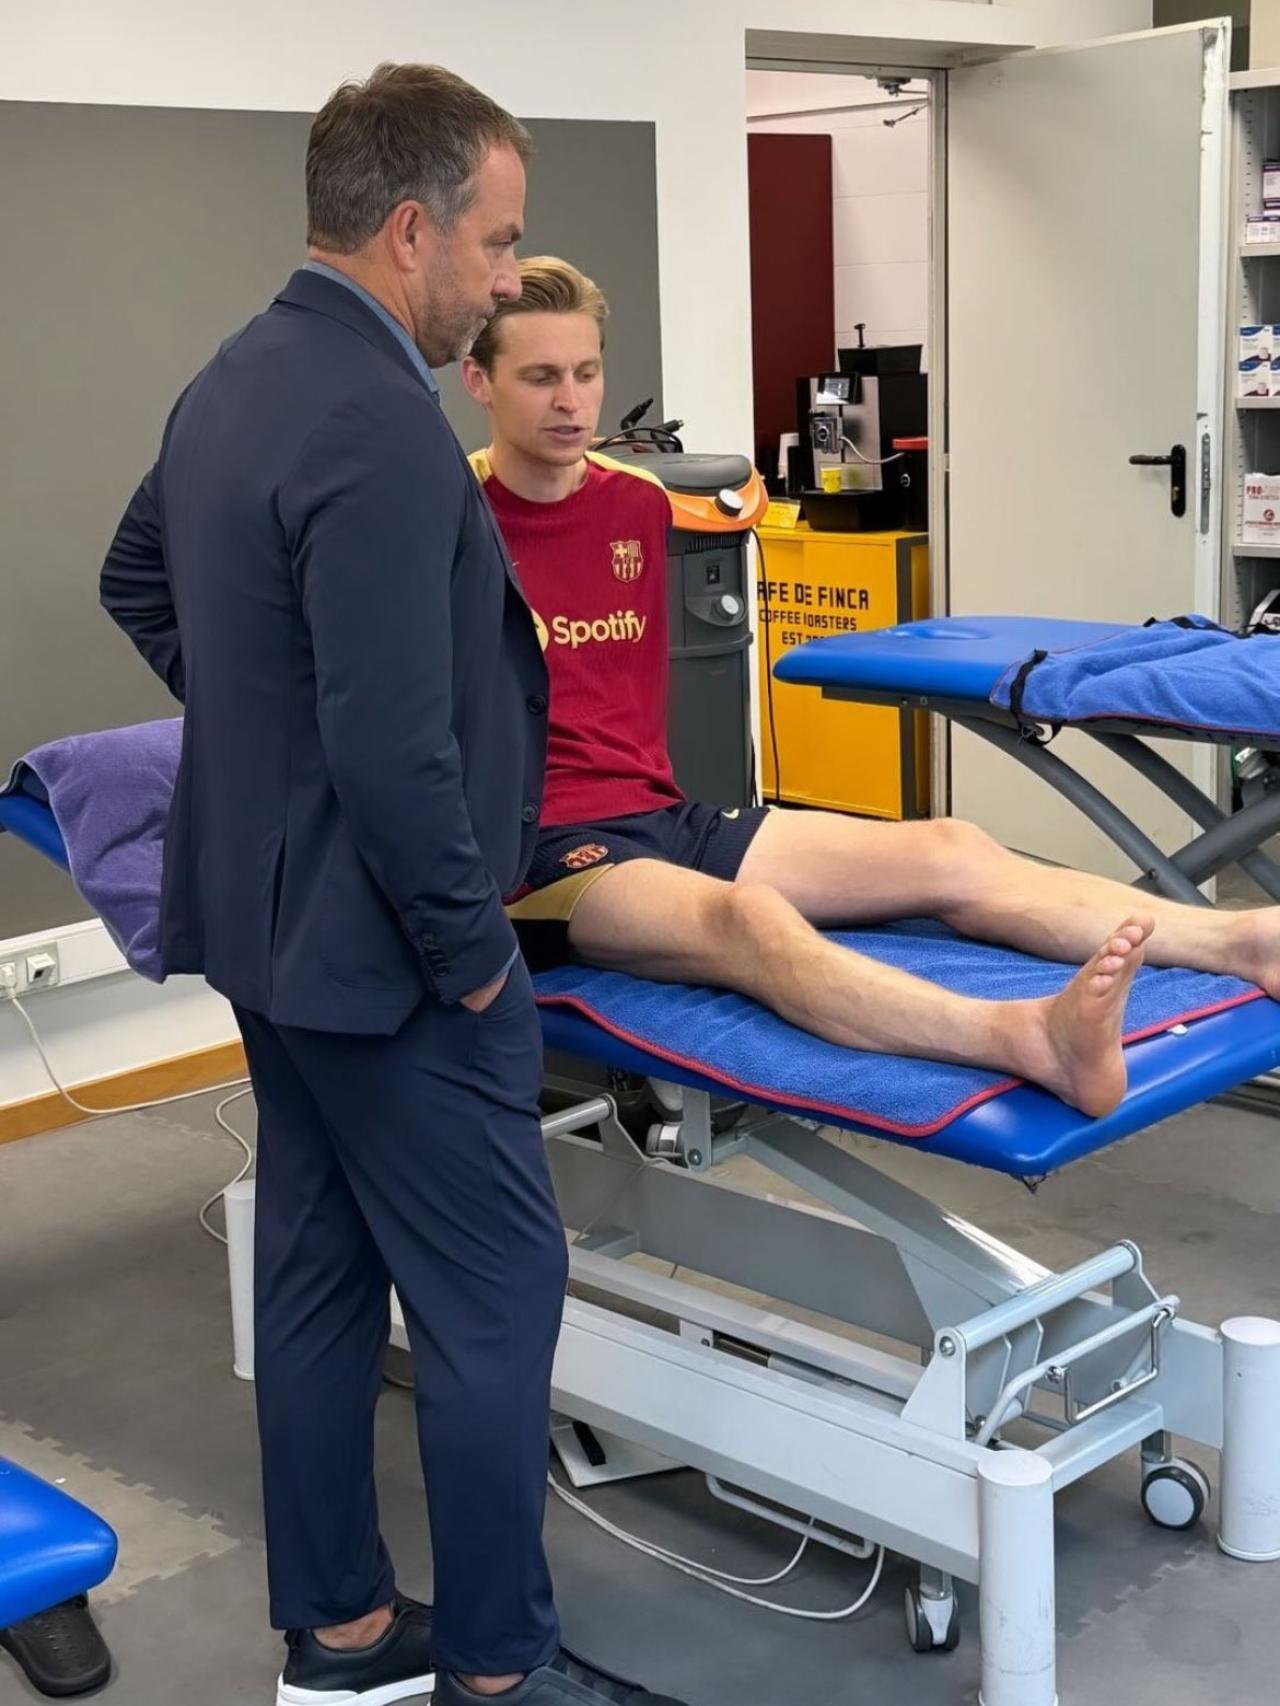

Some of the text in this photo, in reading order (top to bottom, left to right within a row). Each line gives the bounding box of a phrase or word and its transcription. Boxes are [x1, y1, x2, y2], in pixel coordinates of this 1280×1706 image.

[757, 581, 869, 610] AFE DE FINCA
[552, 610, 647, 649] Spotify
[759, 609, 801, 624] COFFEE
